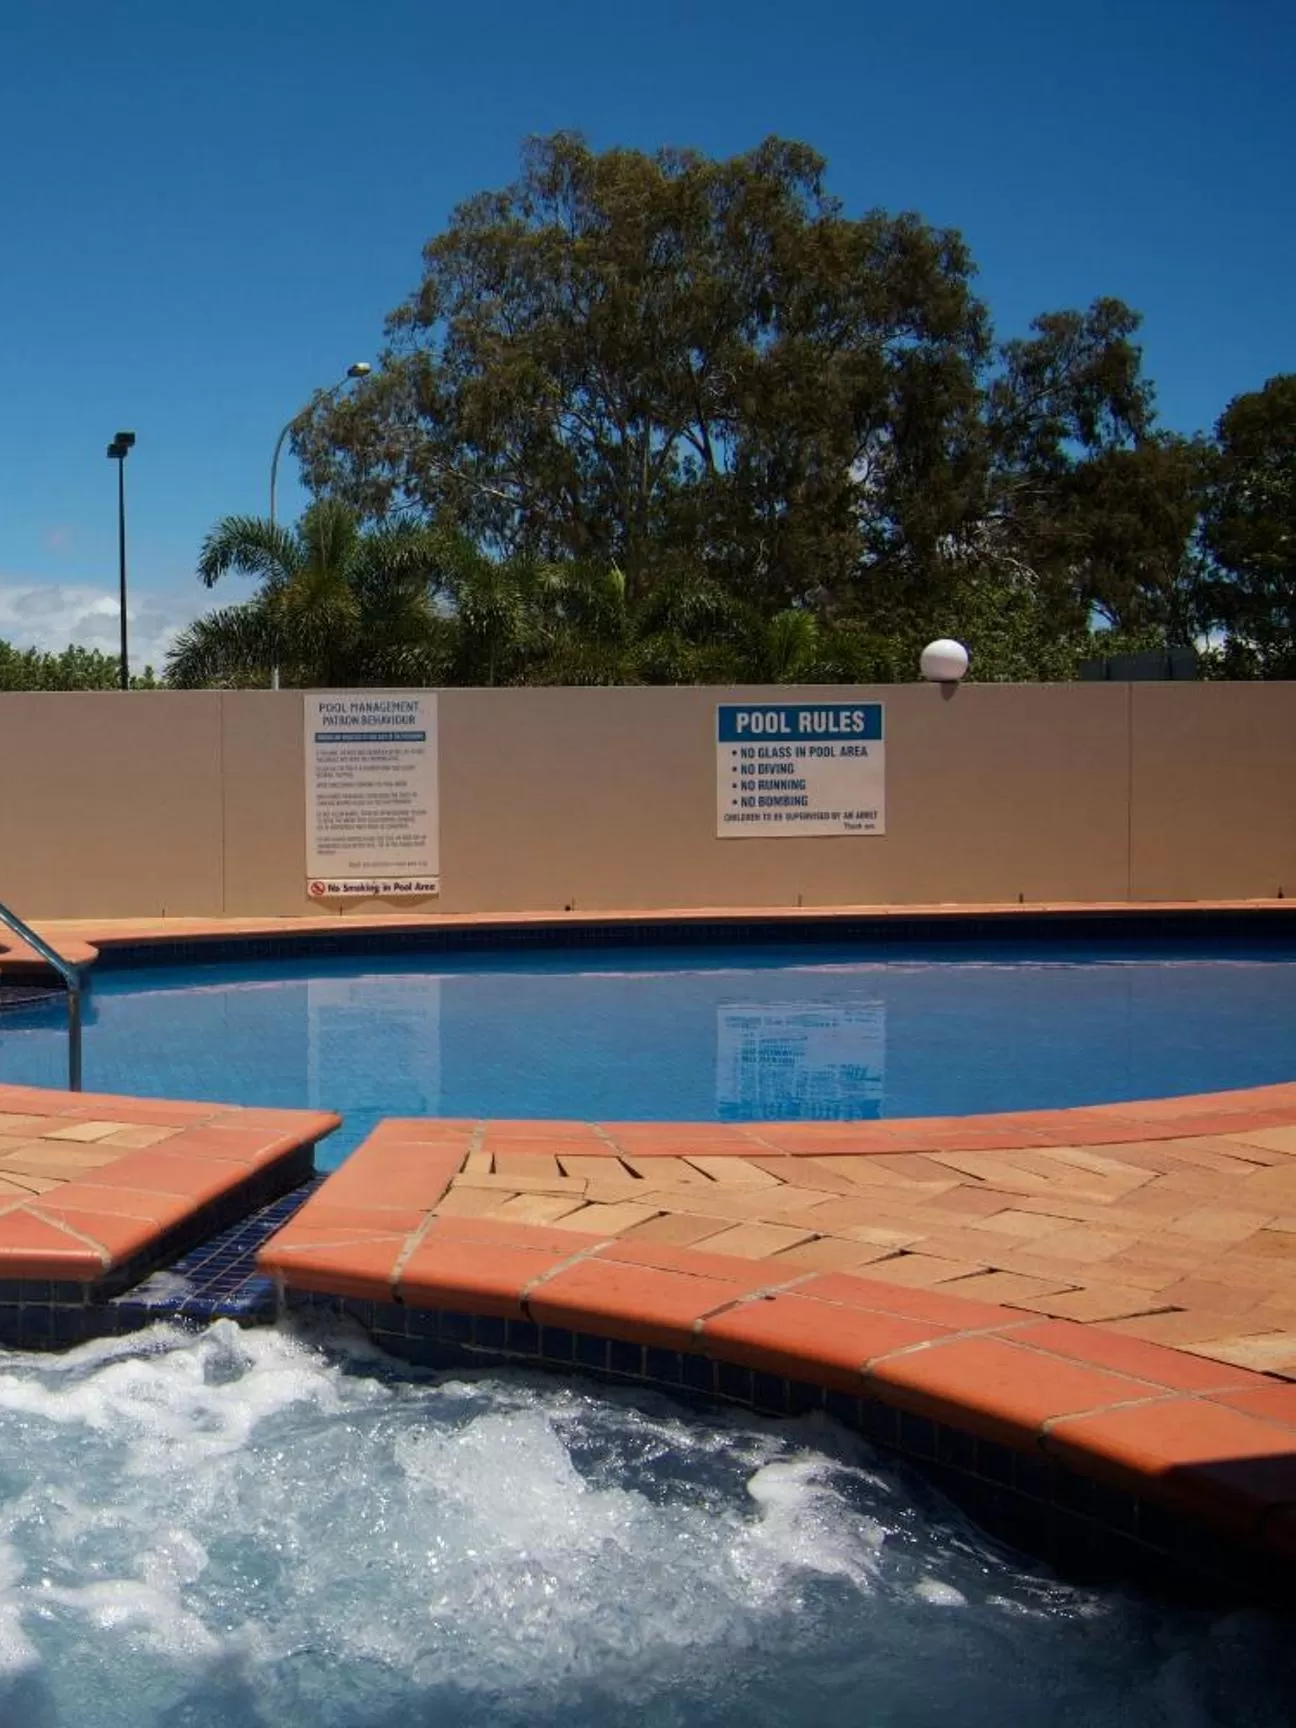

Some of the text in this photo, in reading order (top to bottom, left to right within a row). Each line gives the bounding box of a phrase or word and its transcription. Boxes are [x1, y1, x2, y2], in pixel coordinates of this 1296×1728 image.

[319, 701, 419, 713] POOL MANAGEMENT
[322, 713, 416, 726] PATRON BEHAVIOUR
[736, 710, 865, 734] POOL RULES
[740, 746, 868, 759] NO GLASS IN POOL AREA
[740, 763, 794, 776] NO DIVING
[740, 779, 806, 791] NO RUNNING
[740, 795, 808, 808] NO BOMBING
[763, 812, 772, 821] TO
[831, 811, 841, 820] BY
[328, 882, 436, 896] No Smoking in Pool Area
